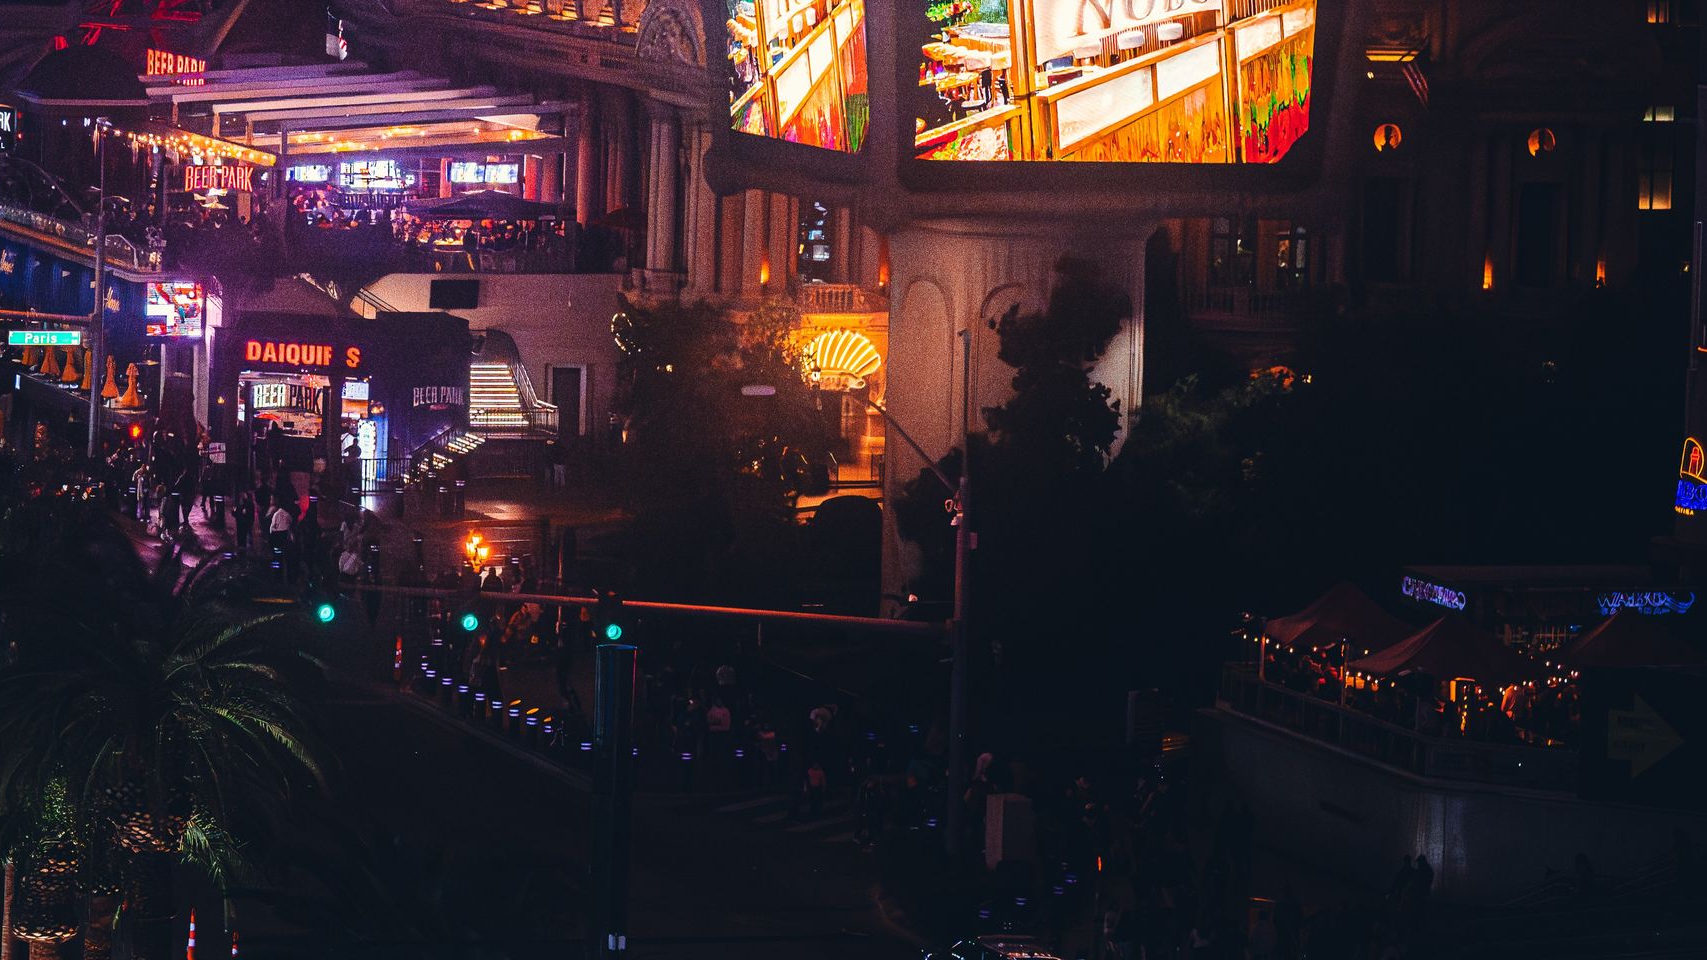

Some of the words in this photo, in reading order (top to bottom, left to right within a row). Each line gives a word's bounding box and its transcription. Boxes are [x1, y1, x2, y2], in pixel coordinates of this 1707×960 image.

[147, 48, 174, 75] BEER
[185, 165, 220, 192] BEER
[221, 165, 254, 193] PARK
[24, 332, 58, 344] Paris
[253, 383, 285, 409] BEER
[413, 387, 438, 408] BEER
